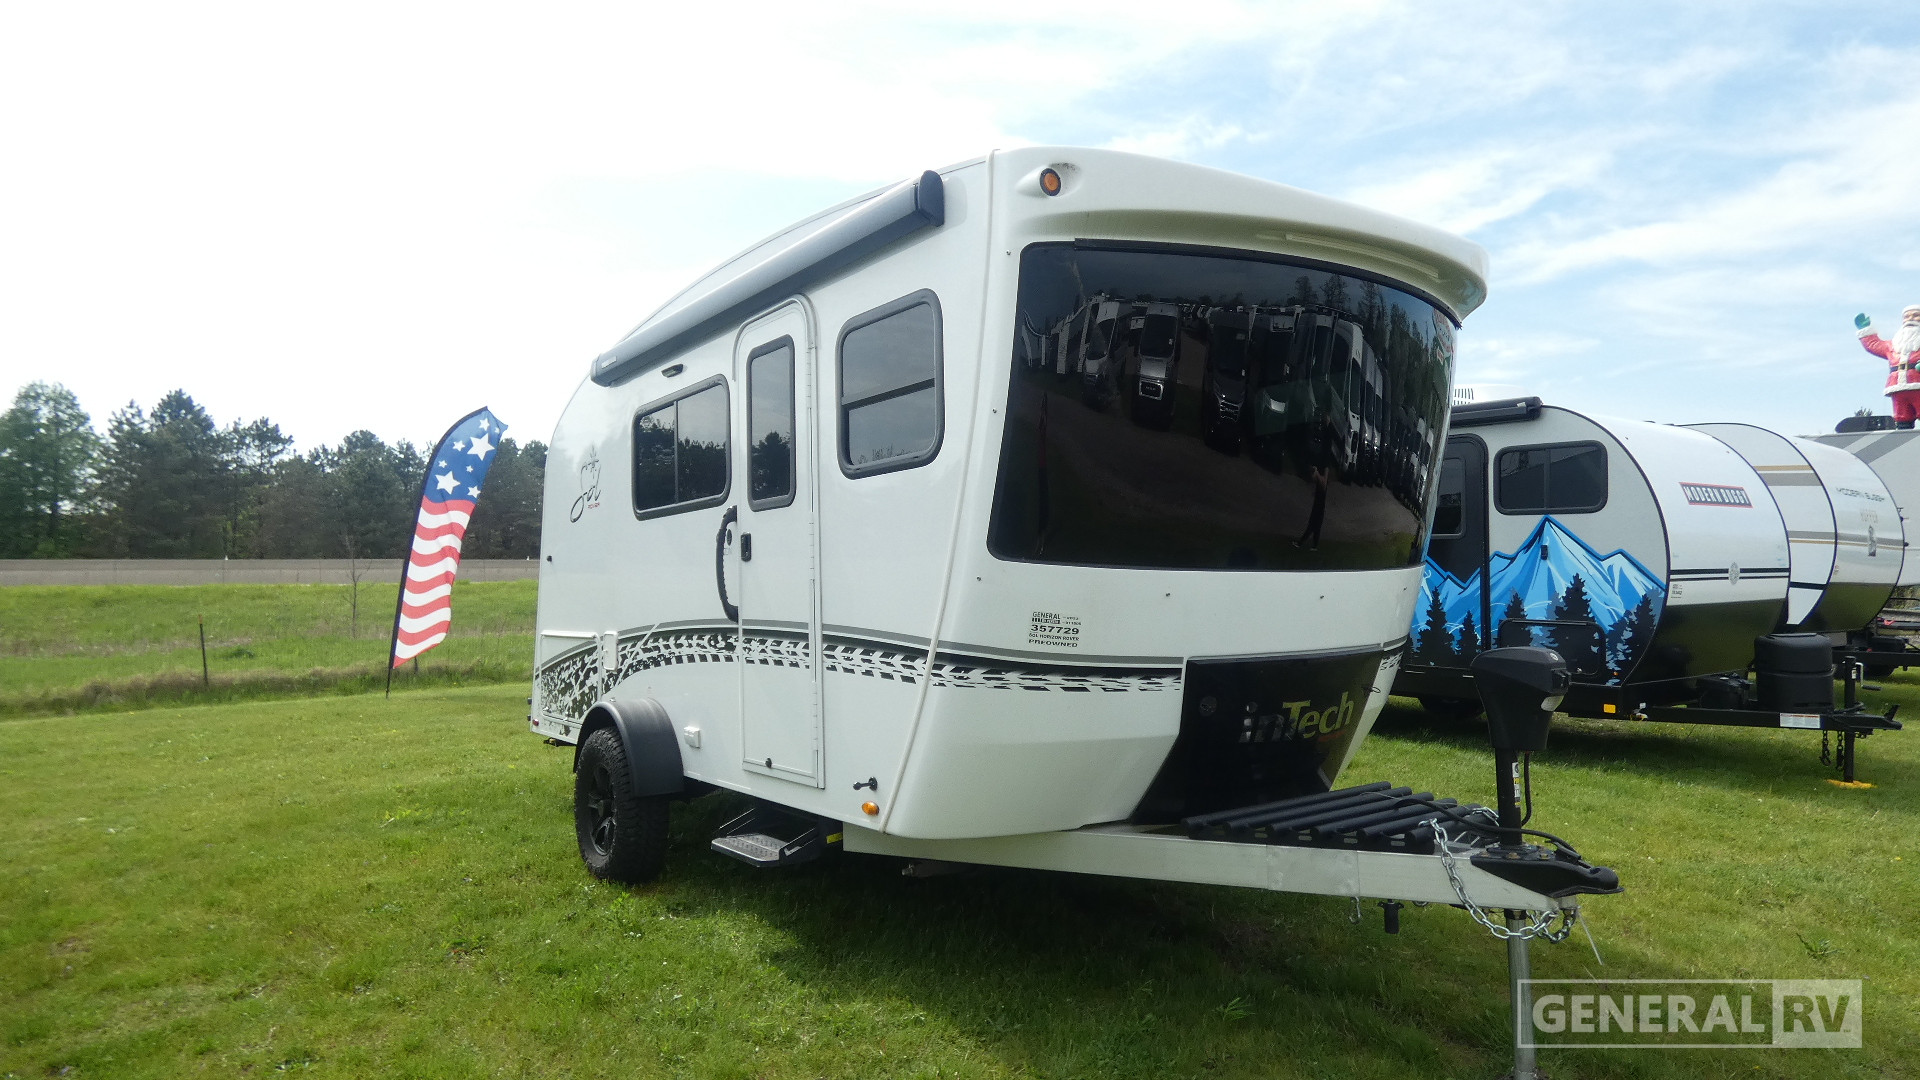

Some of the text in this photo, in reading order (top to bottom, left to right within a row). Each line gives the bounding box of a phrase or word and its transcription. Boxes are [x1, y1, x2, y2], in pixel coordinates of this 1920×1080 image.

[1683, 486, 1749, 504] MODERN BUGGY
[1032, 611, 1061, 620] GENERAL
[1030, 624, 1080, 635] 357729
[1028, 639, 1078, 648] PREOWNED
